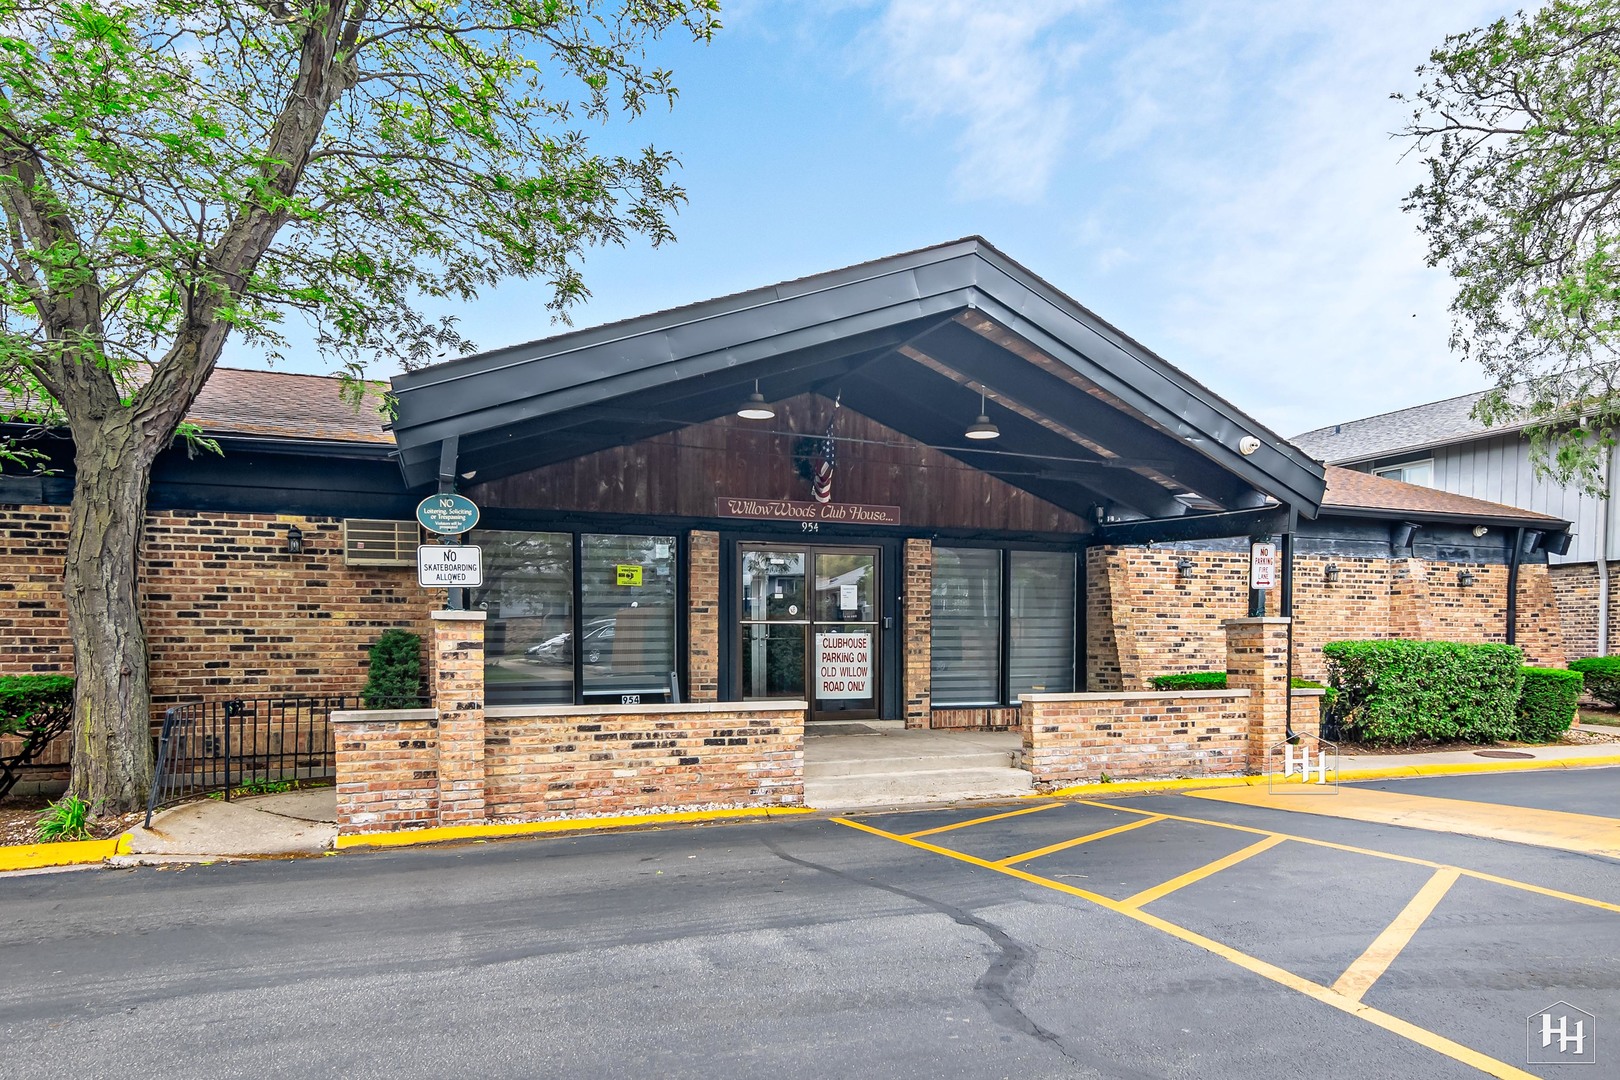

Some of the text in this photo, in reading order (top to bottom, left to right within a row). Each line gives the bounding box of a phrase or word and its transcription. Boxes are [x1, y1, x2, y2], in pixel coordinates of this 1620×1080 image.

[440, 499, 454, 508] NO
[728, 500, 771, 516] Willow
[768, 502, 816, 518] Woods
[820, 505, 846, 519] Club
[802, 522, 818, 532] 954
[444, 552, 456, 562] NO
[424, 564, 477, 572] SKATEBOARDING
[822, 638, 866, 648] CLUBHOUSE
[822, 652, 868, 662] PARKING ON
[821, 666, 868, 677] OLD WILLOW
[824, 681, 866, 692] ROAD ONLY
[622, 696, 639, 704] 954
